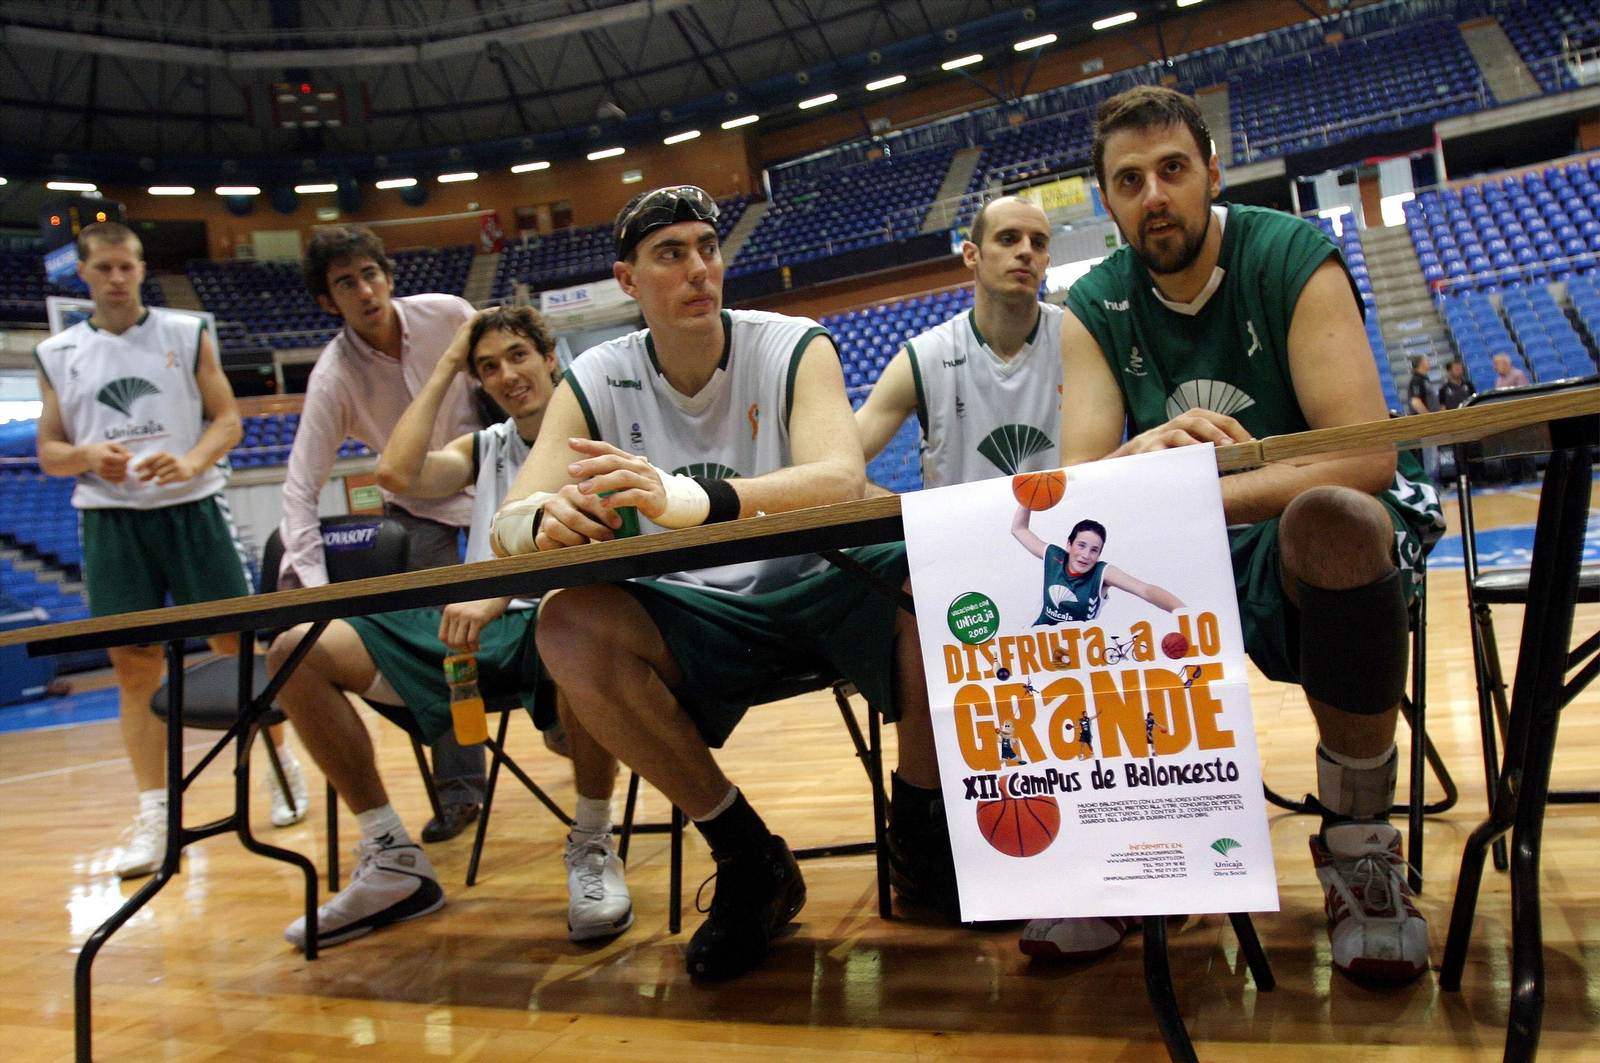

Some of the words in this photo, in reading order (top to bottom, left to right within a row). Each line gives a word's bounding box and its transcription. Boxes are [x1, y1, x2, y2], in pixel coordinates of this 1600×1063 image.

[104, 420, 165, 440] Unicaja
[323, 527, 376, 547] OVASOFT
[1046, 605, 1074, 621] Unicaja
[967, 626, 989, 639] 2008
[1177, 611, 1221, 658] LO
[962, 774, 999, 800] XII
[1091, 760, 1117, 790] de
[1124, 757, 1240, 788] Baloncesto
[1099, 799, 1138, 808] BALONCESTO
[1215, 860, 1243, 869] Unicaja
